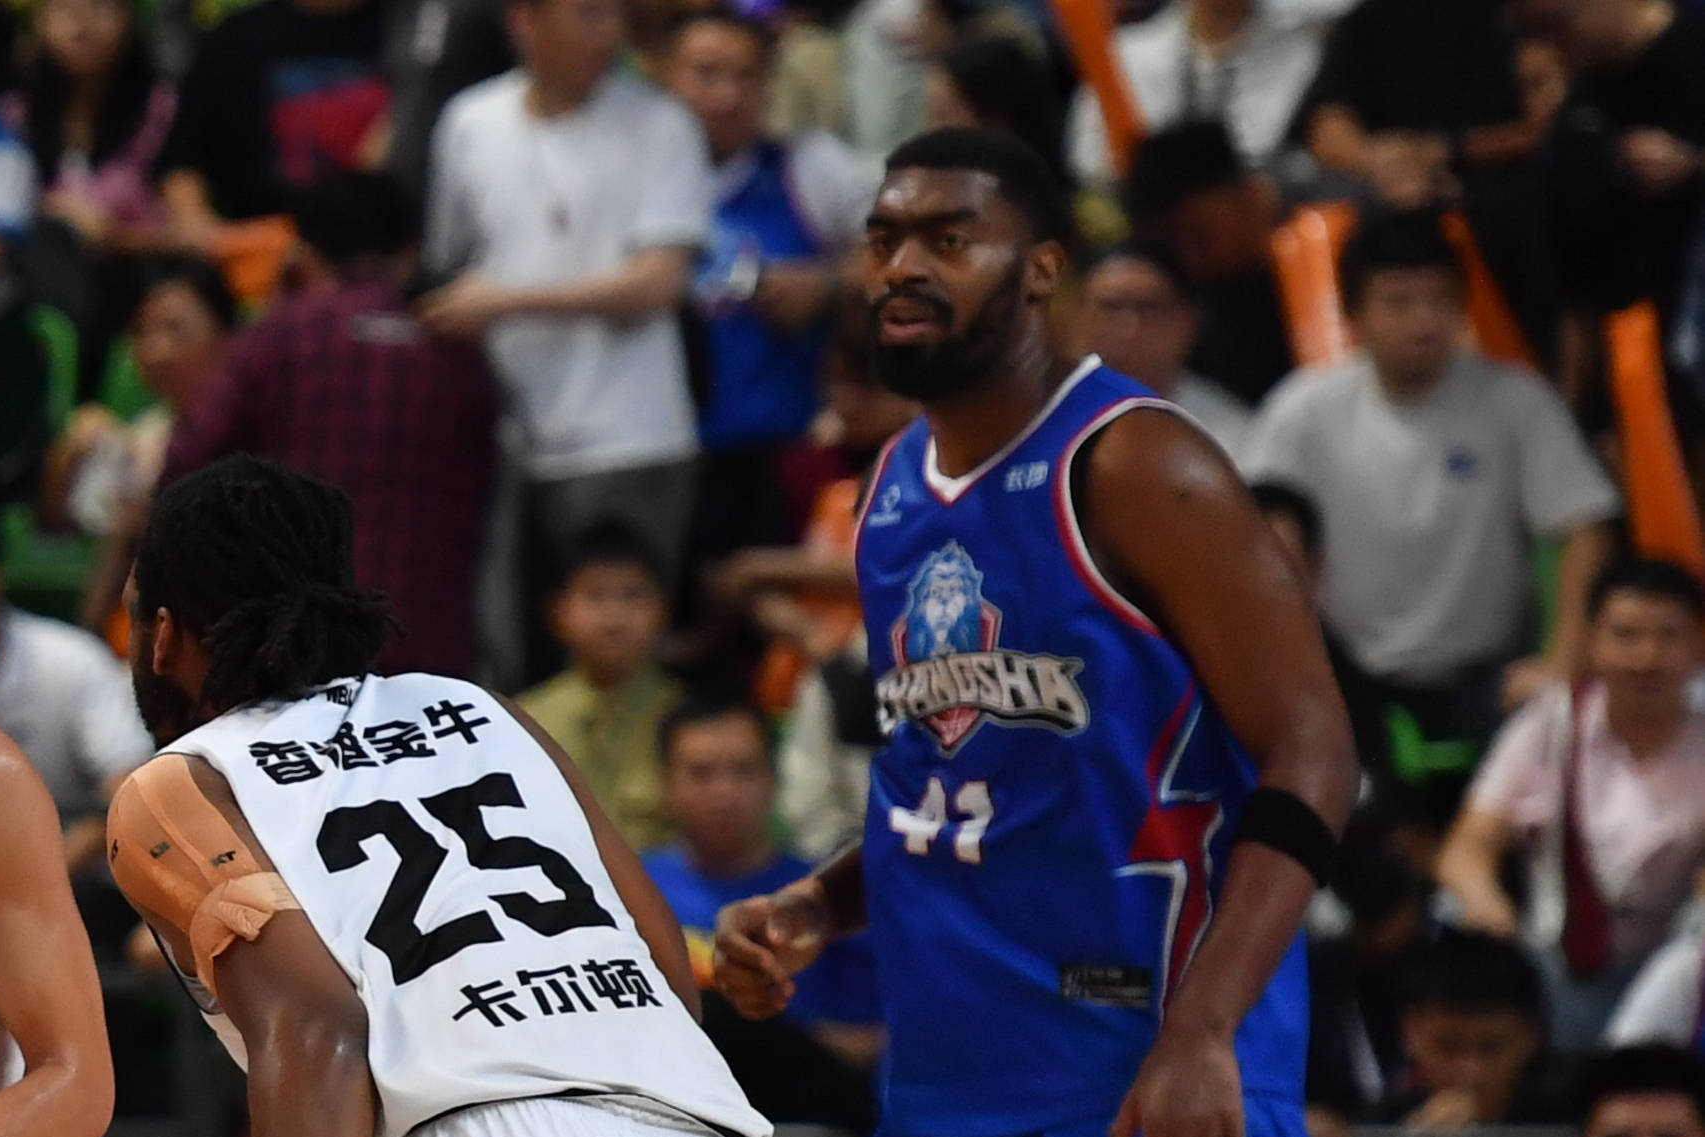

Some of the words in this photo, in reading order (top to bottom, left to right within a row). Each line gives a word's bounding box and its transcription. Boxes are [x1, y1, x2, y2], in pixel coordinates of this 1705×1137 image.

[247, 699, 492, 786] 香港金牛
[316, 773, 619, 986] 25
[451, 957, 664, 1028] 卡尔顿
